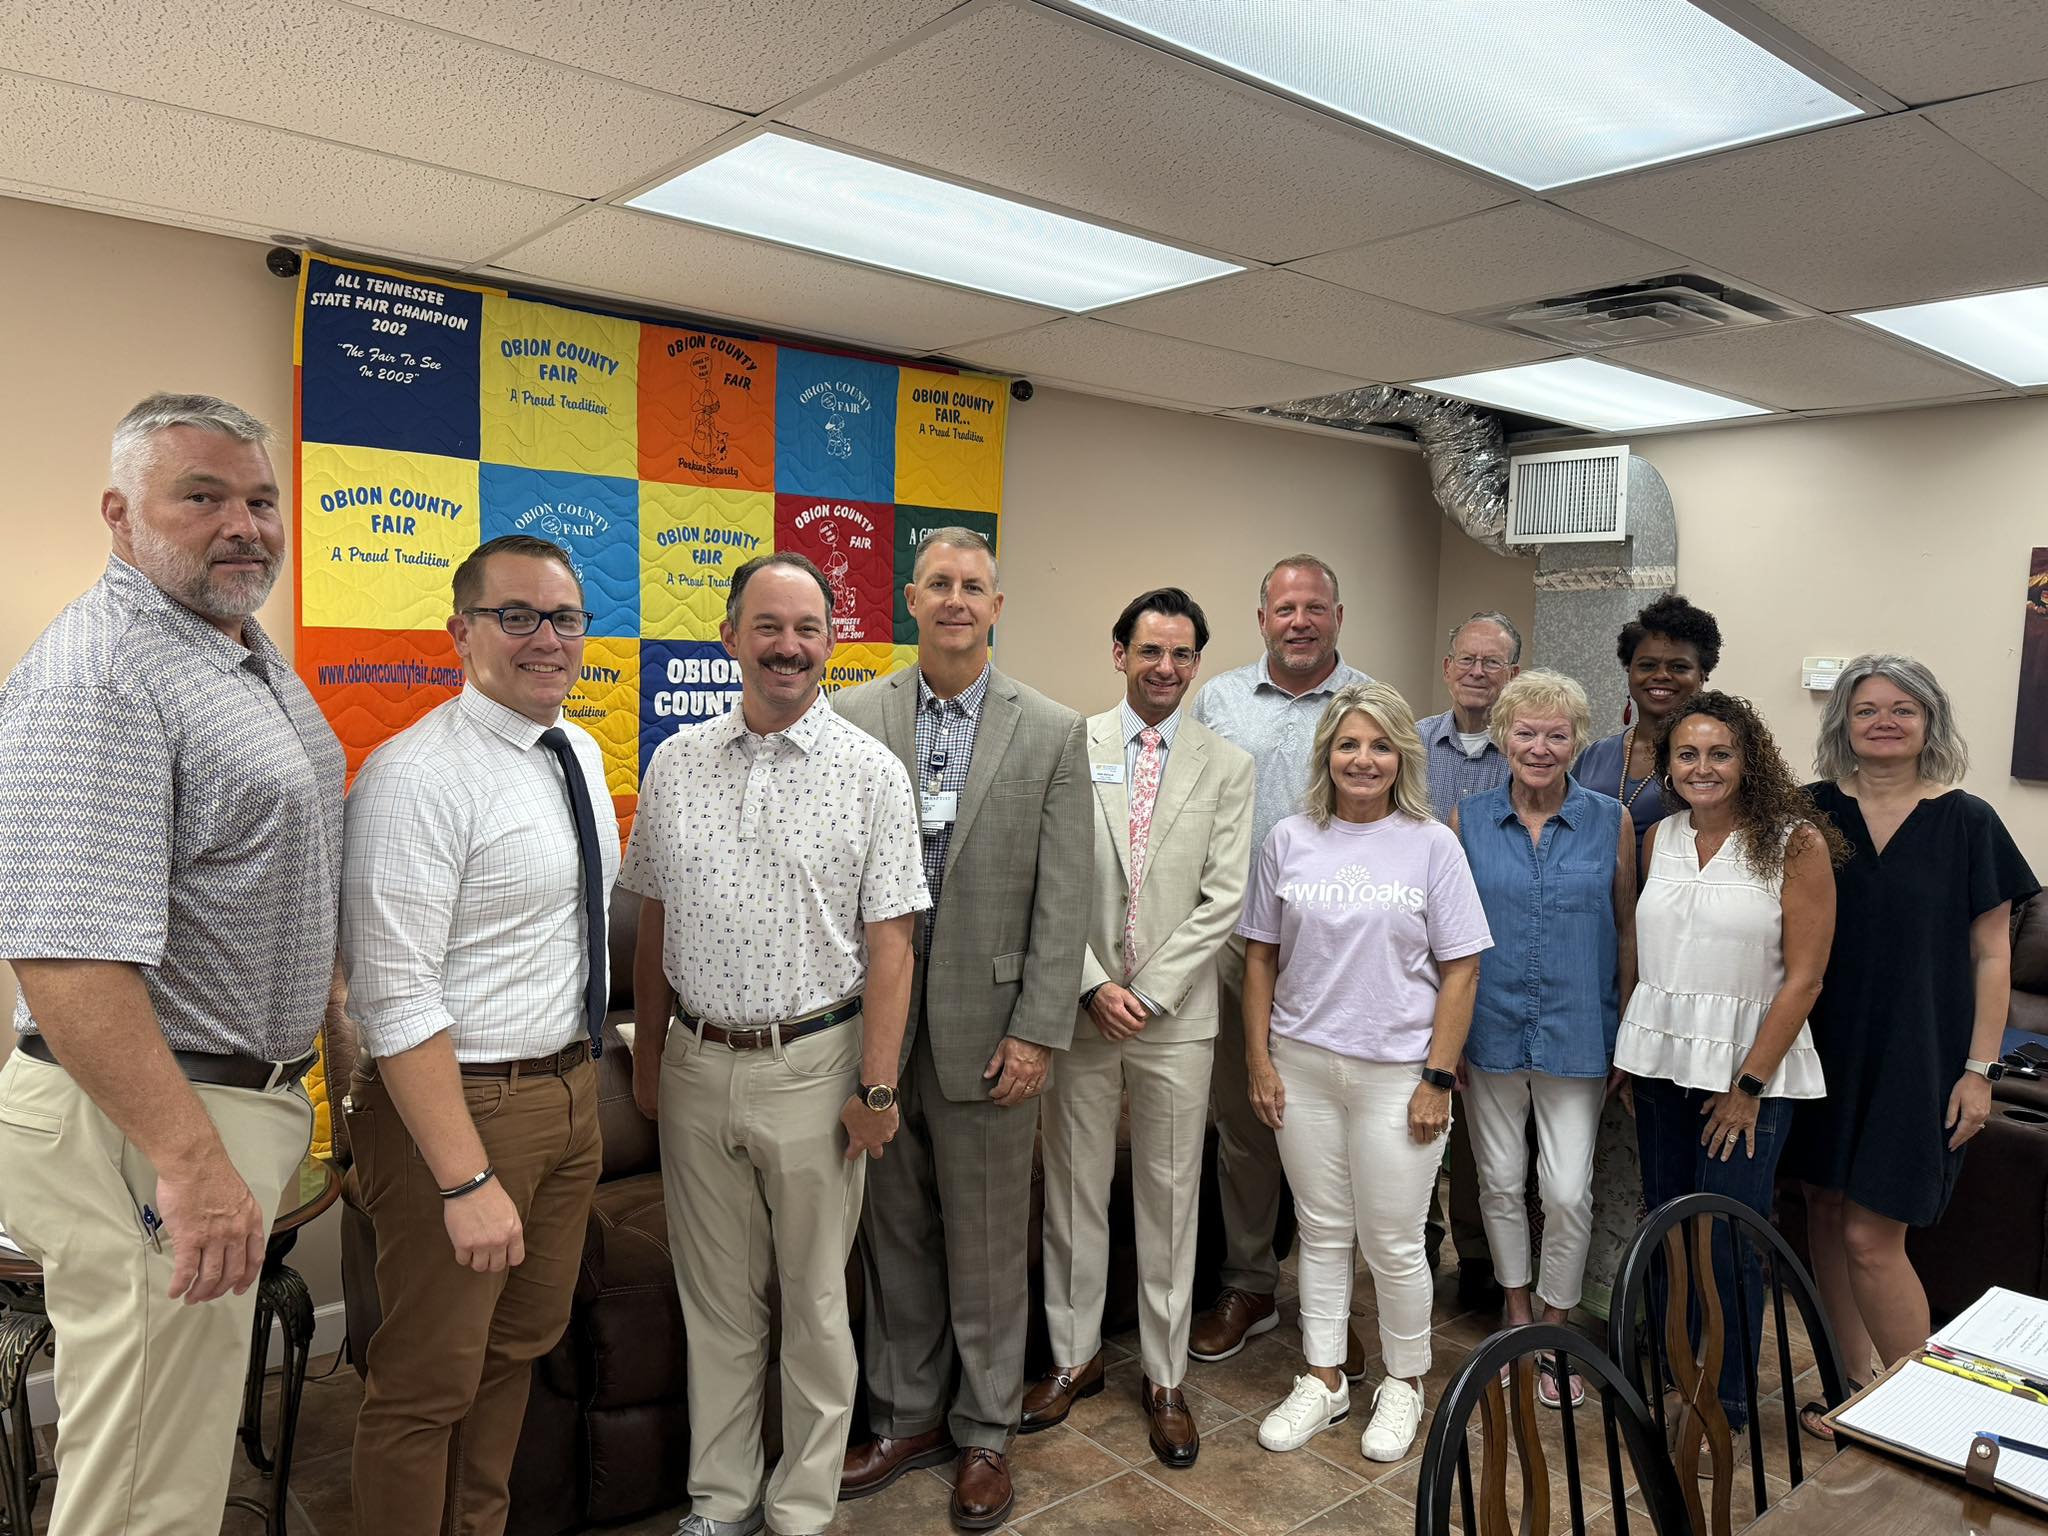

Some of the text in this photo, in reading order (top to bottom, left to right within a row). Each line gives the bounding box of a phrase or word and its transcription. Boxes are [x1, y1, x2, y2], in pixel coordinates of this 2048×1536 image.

[335, 273, 445, 306] ALL TENNESSEE
[310, 292, 469, 331] STATE FAIR CHAMPION
[371, 318, 408, 336] 2002
[368, 348, 397, 363] Fair
[400, 353, 416, 366] To
[420, 356, 442, 370] See
[501, 338, 619, 376] OBION COUNTY
[667, 335, 757, 371] OBION COUNTY
[359, 365, 374, 377] In
[539, 364, 578, 385] FAIR
[723, 373, 751, 391] FAIR
[521, 390, 556, 407] Proud
[799, 381, 832, 404] OBION
[836, 381, 872, 411] COUNTY
[912, 388, 994, 414] OBION COUNTY
[837, 401, 860, 414] FAIR
[935, 407, 970, 425] FAIR...
[919, 423, 984, 443] A Proud Tradition
[706, 462, 738, 479] Security
[320, 486, 462, 520] OBION COUNTY
[371, 514, 416, 536] FAIR
[514, 502, 554, 530] OBION
[558, 502, 611, 532] COUNTY
[794, 504, 874, 532] OBION COUNTY
[563, 523, 594, 536] FAIR
[657, 526, 760, 550] OBION COUNTY
[909, 528, 917, 545] A
[849, 535, 871, 550] FAIR
[348, 546, 389, 562] Proud
[692, 549, 723, 565] FAIR
[666, 572, 674, 585] A
[678, 573, 704, 586] Proud
[581, 665, 620, 684] UNTY
[831, 666, 877, 682] COUNTY
[561, 705, 607, 718] Tradition
[654, 690, 743, 716] COUNT
